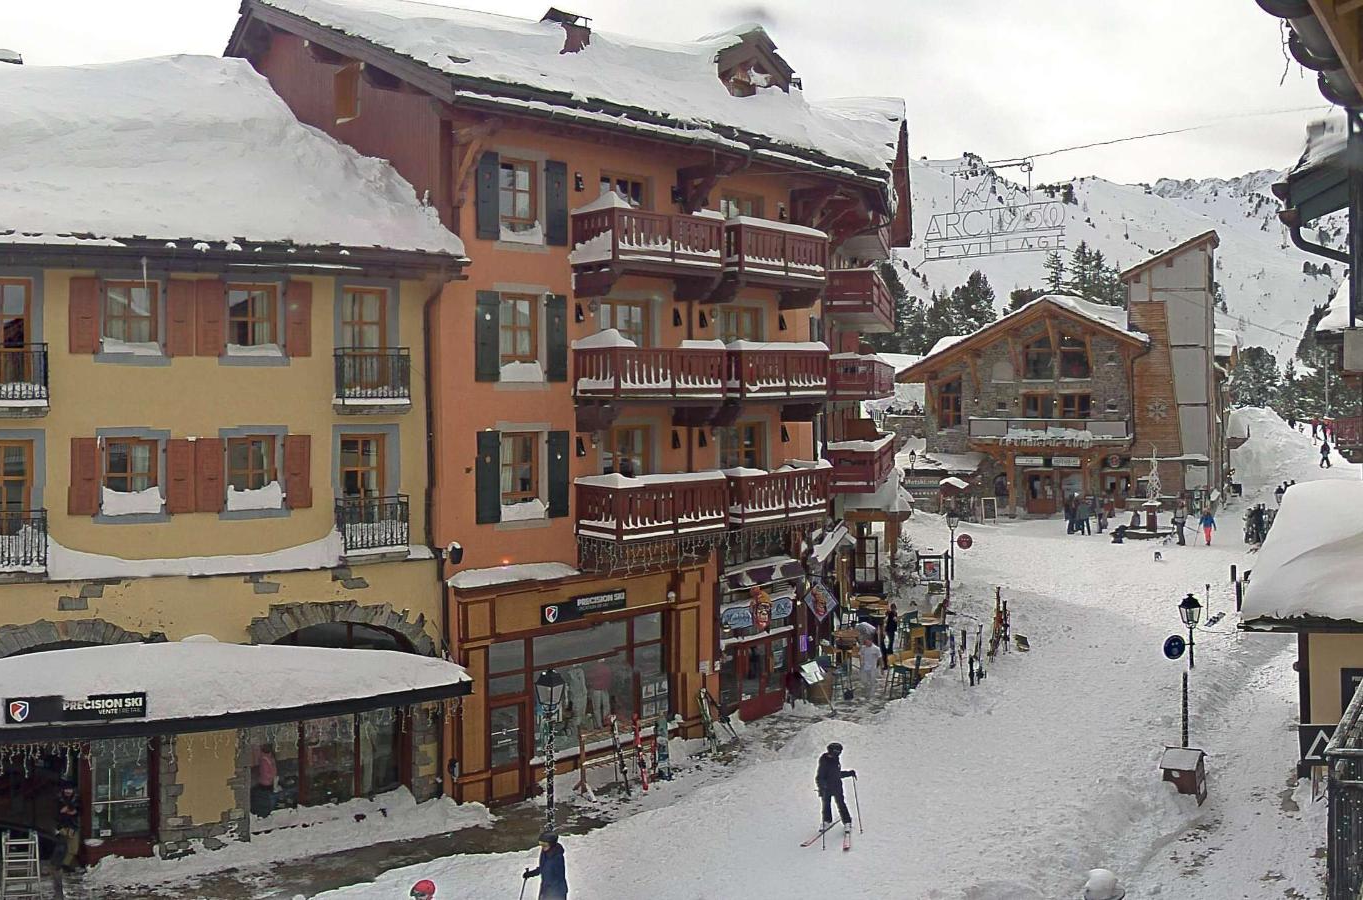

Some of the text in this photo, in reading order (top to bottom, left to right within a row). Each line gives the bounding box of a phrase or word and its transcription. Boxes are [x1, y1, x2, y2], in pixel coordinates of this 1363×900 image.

[924, 201, 1065, 240] ARC 1950
[62, 697, 143, 711] PRECISION SKI
